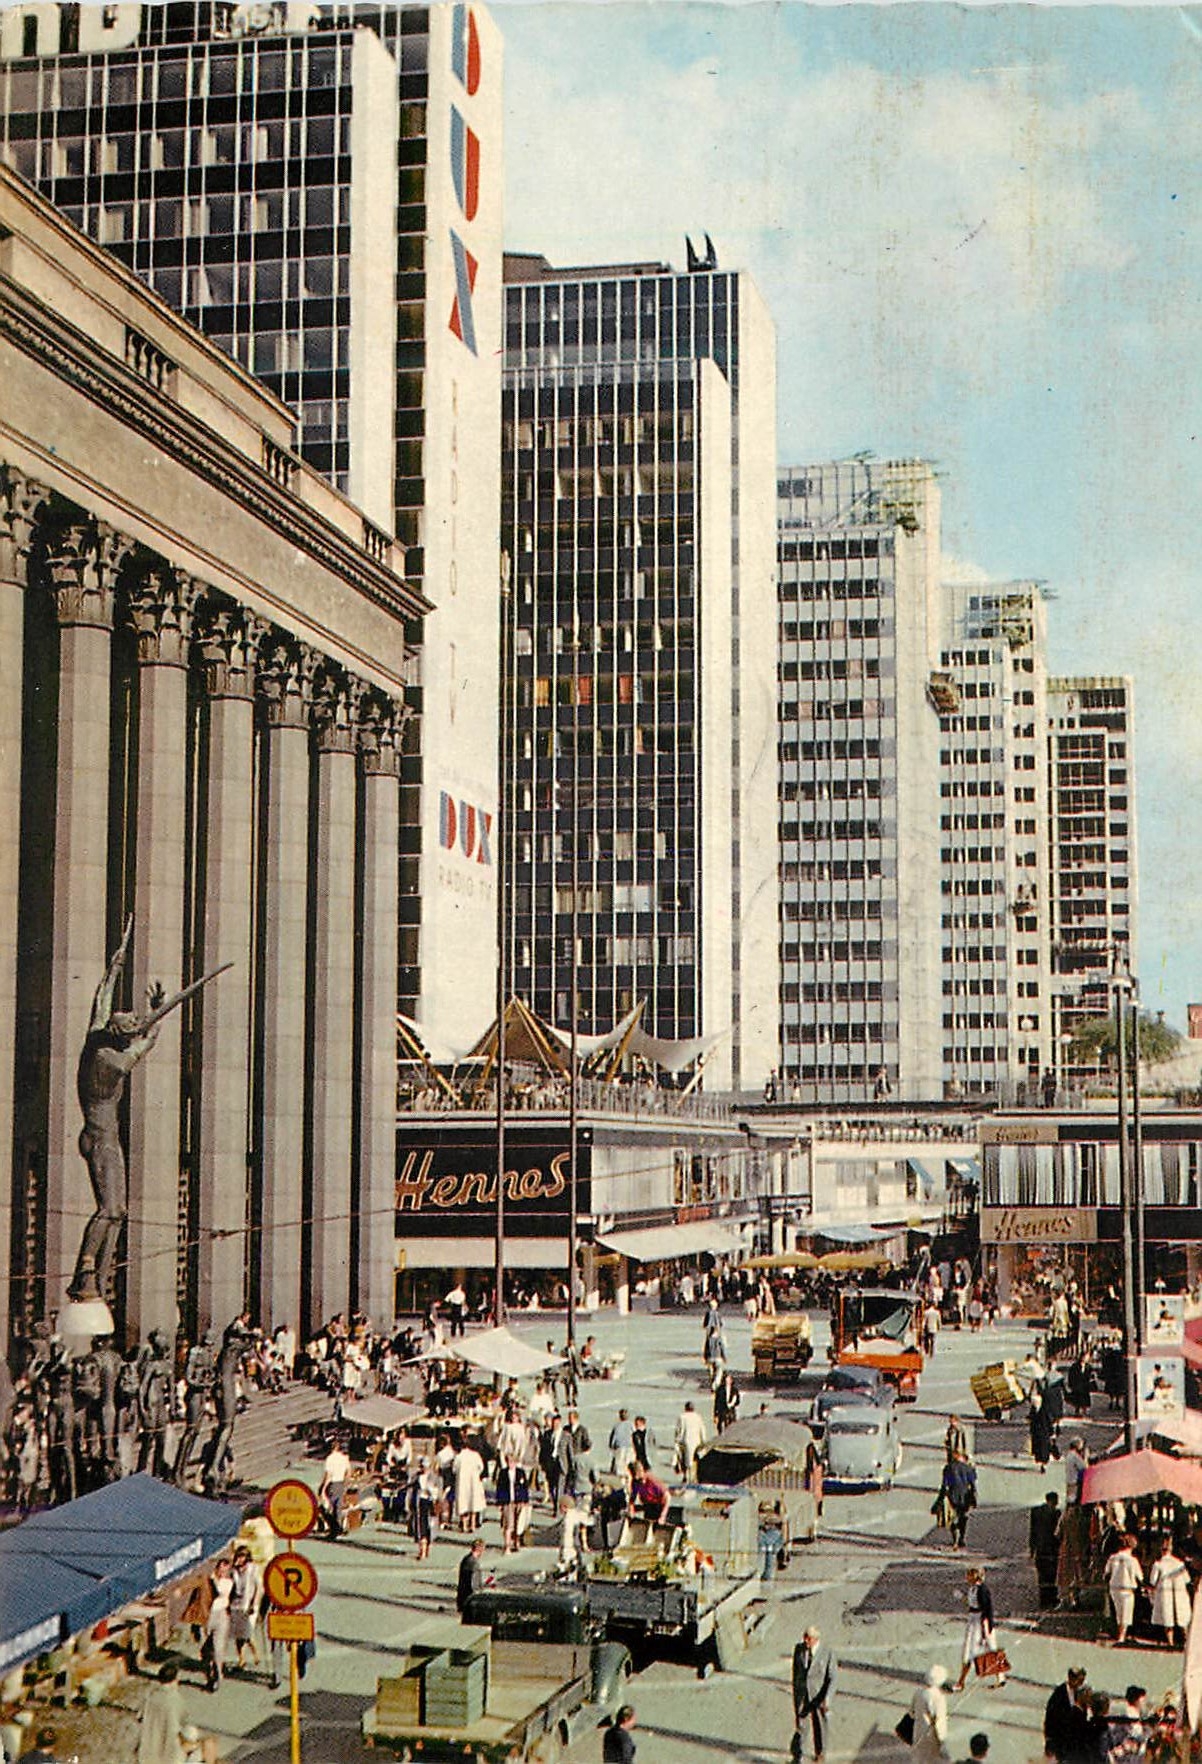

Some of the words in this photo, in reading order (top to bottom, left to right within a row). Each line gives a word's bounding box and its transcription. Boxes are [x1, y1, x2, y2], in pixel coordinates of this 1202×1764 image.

[448, 4, 481, 357] DUX
[439, 790, 492, 865] DUX
[284, 1567, 303, 1597] P
